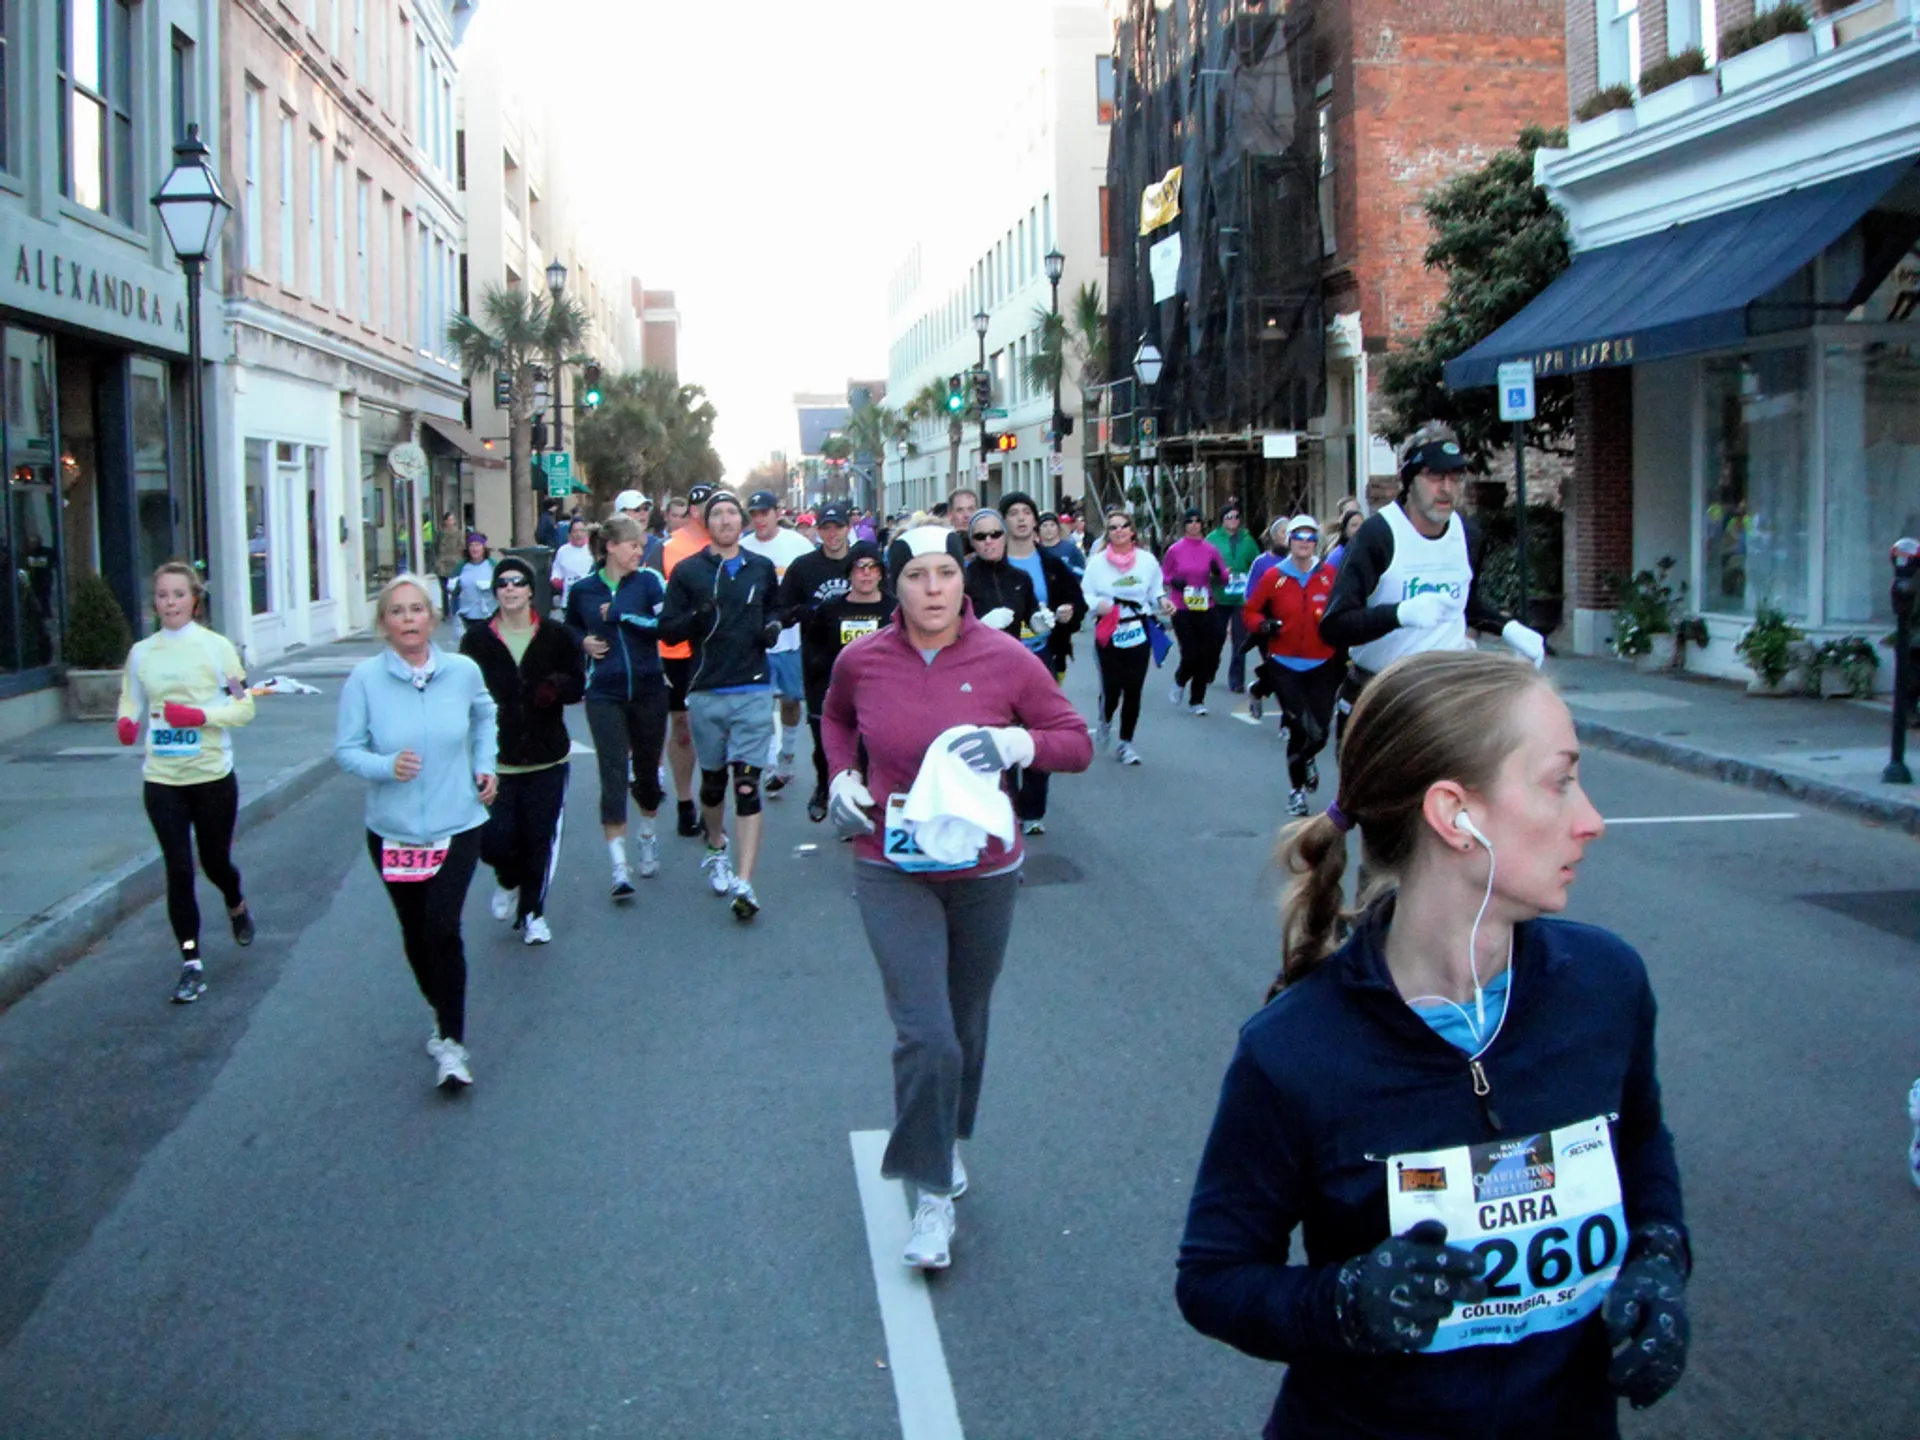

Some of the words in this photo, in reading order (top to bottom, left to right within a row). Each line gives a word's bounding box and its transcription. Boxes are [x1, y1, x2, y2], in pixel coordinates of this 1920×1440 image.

[15, 244, 163, 327] ALEXANDRA
[555, 455, 565, 466] P
[386, 848, 444, 868] 3315
[1478, 1193, 1558, 1231] CARA
[1462, 1293, 1551, 1320] COLUMBIA,
[1556, 1287, 1577, 1303] SC
